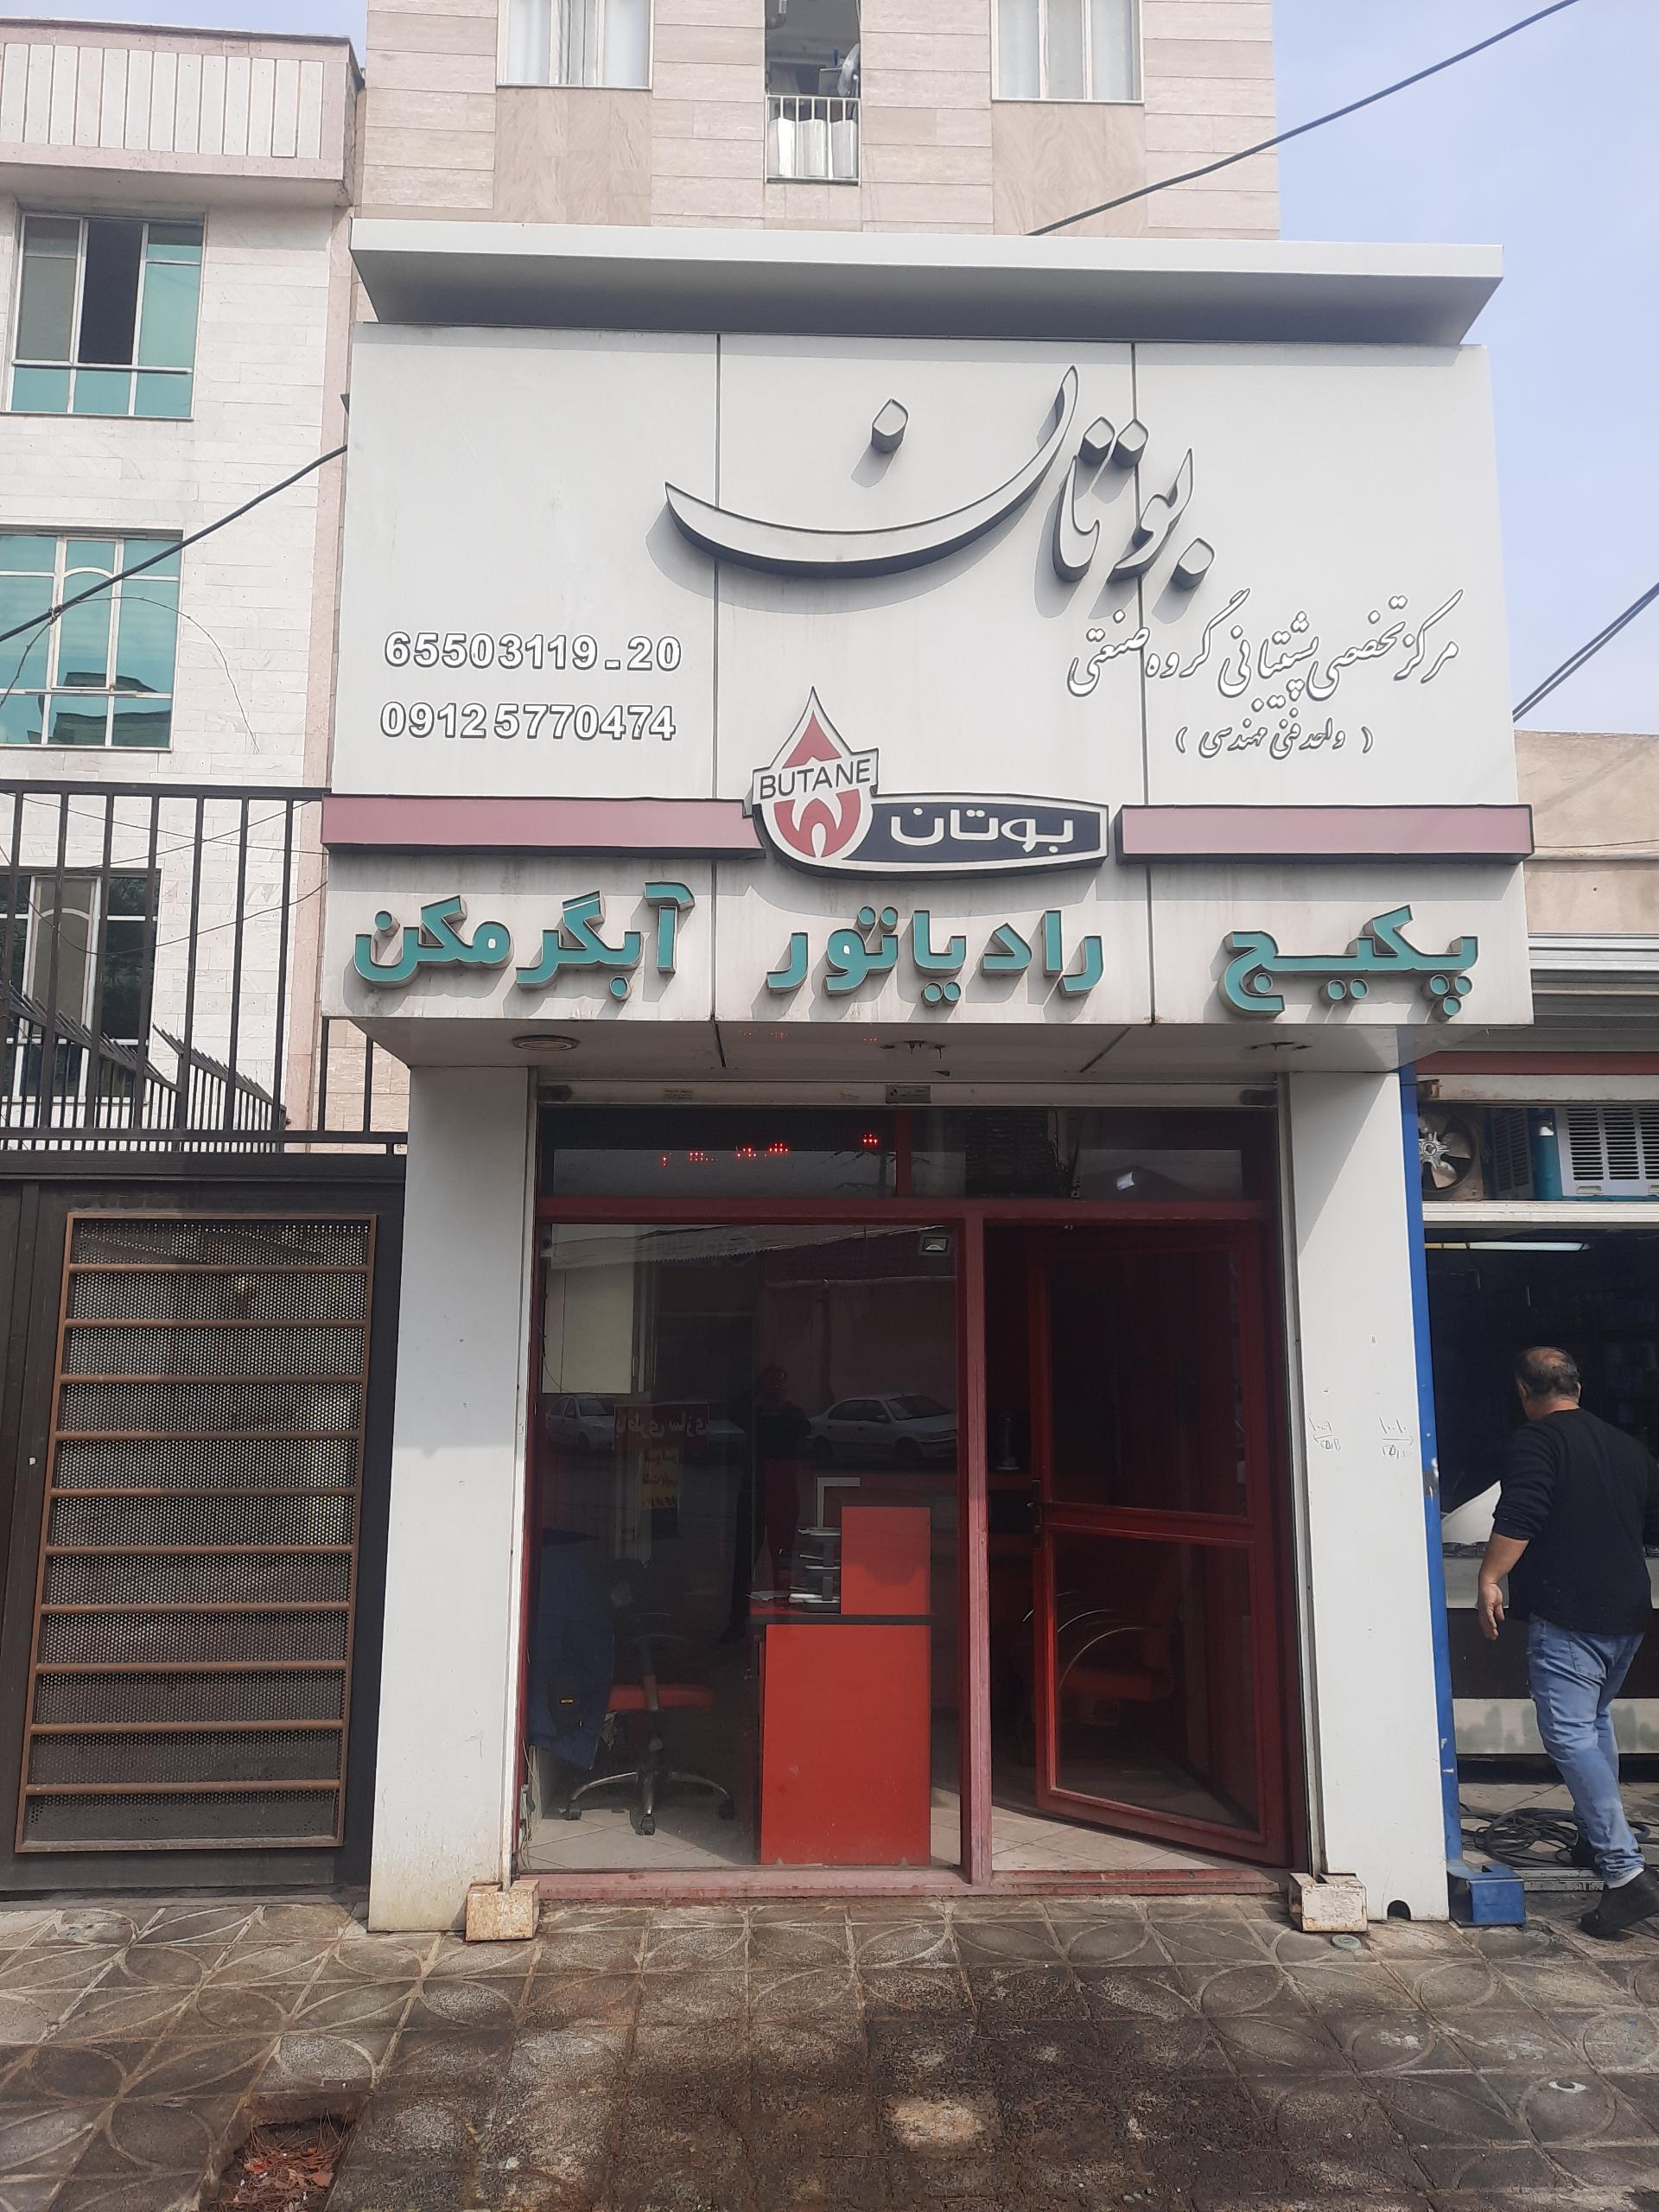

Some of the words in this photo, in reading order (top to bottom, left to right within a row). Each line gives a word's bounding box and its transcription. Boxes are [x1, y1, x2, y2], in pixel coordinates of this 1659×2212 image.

[664, 365, 1215, 589] بوتان
[1066, 608, 1151, 697] صنعتی
[1145, 588, 1250, 678] گروه
[1217, 610, 1319, 713] پشتیبانی
[1306, 594, 1408, 702] تخصصی
[1393, 588, 1464, 684] مرکز
[760, 758, 871, 800] BUTANE
[890, 806, 1075, 854] بوتان
[353, 881, 695, 1001] آبگرمکن
[766, 906, 1104, 1007] رادیاتور
[1222, 904, 1479, 1017] پکیج
